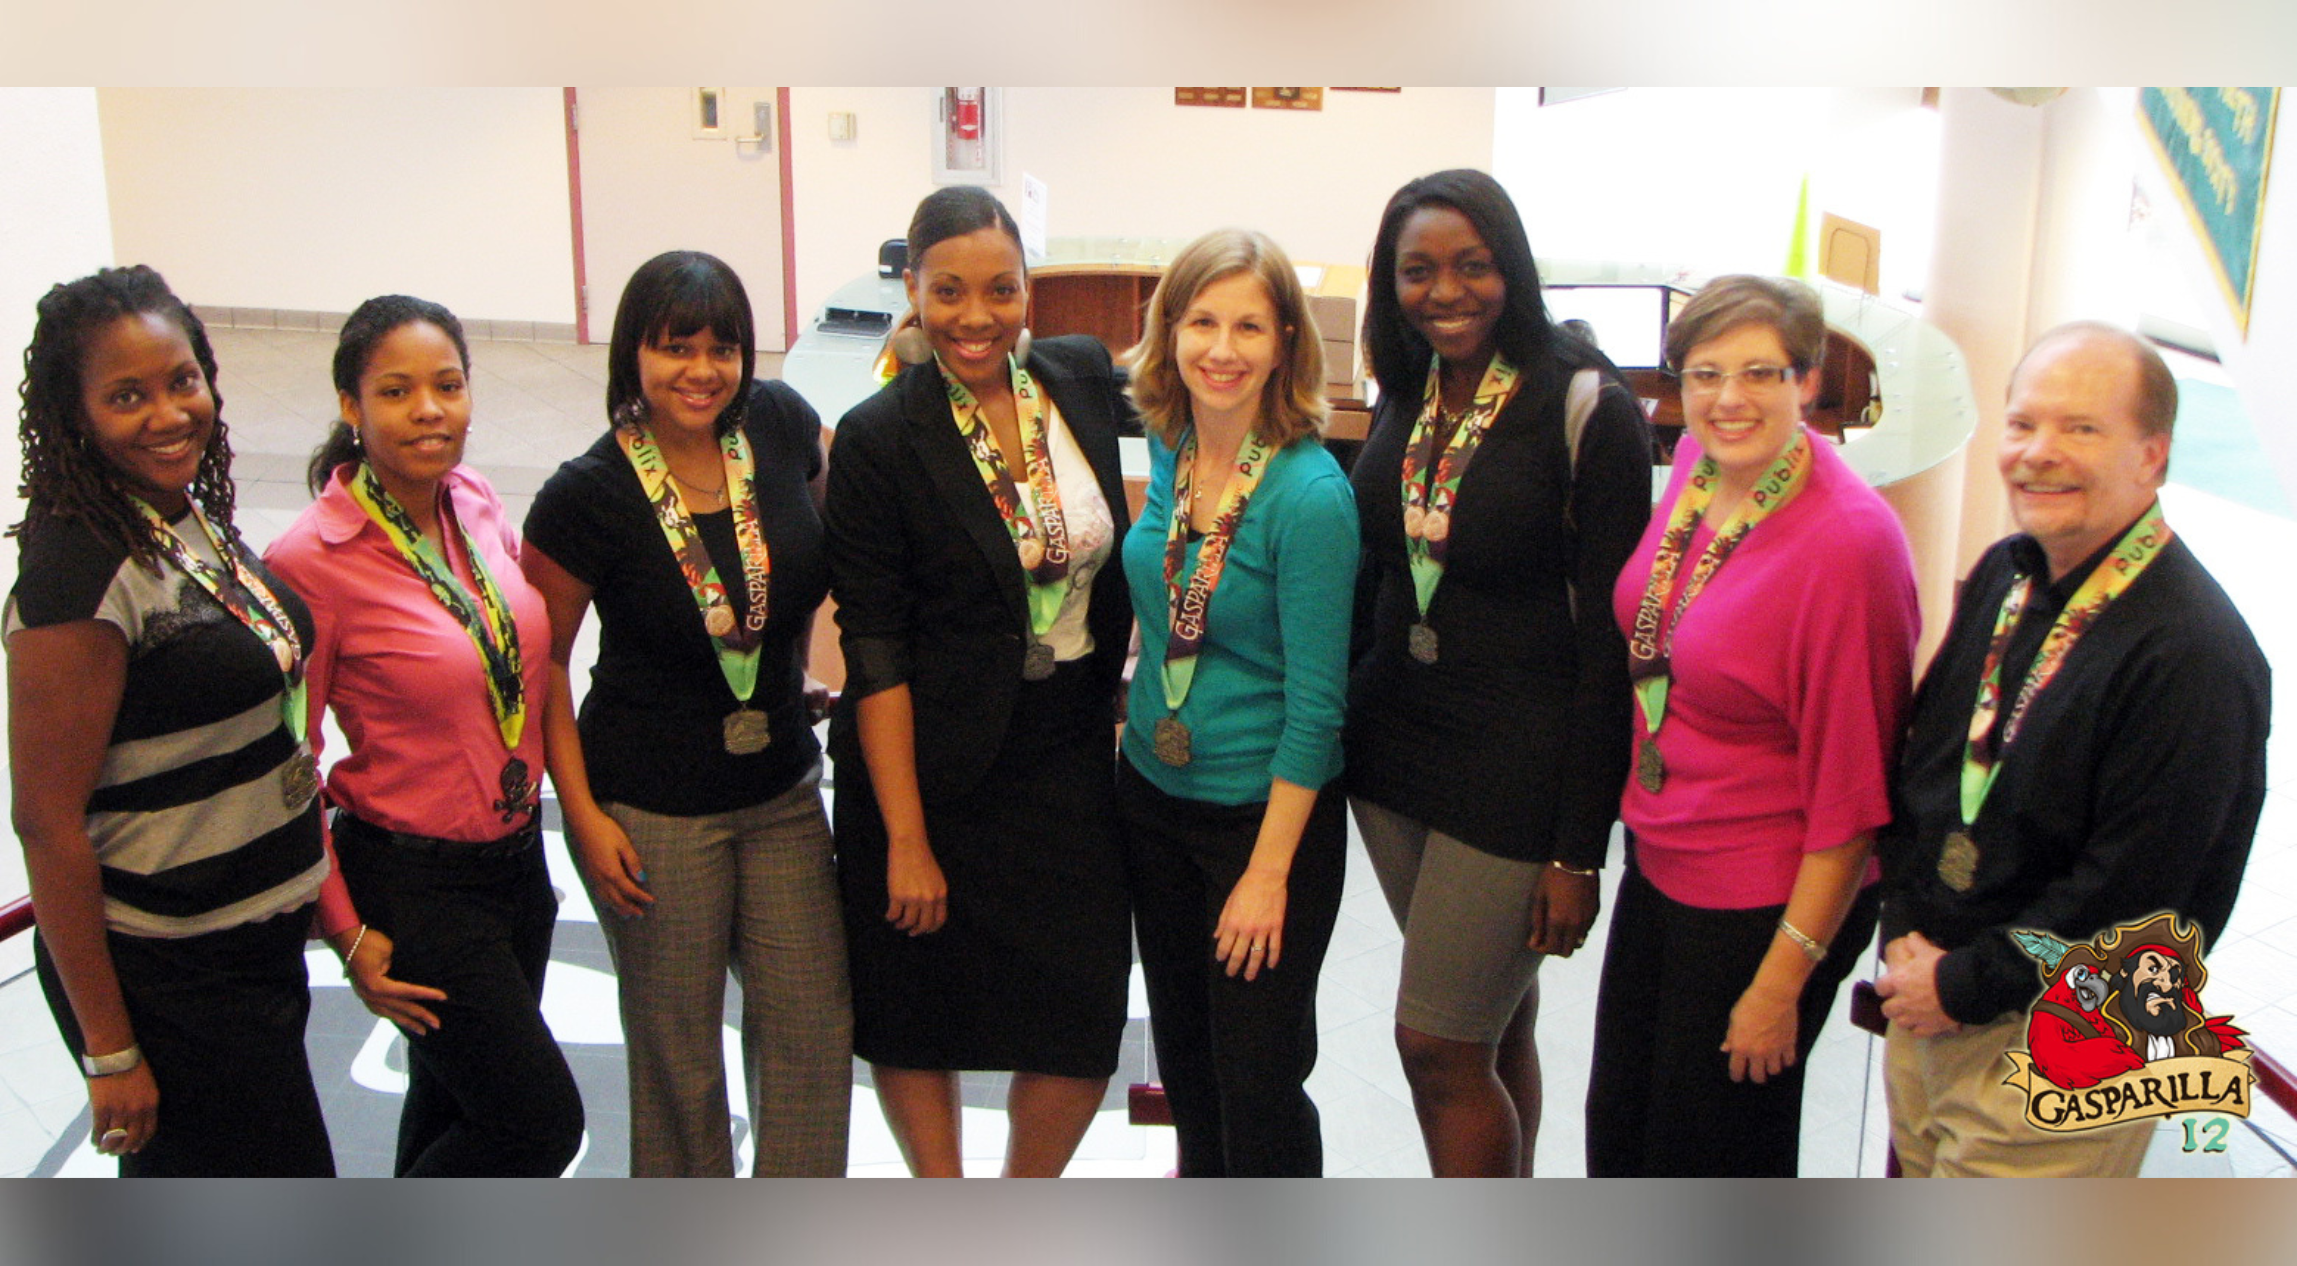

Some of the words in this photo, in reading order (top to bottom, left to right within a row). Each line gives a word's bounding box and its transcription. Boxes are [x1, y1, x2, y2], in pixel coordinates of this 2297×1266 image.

[630, 427, 658, 478] blix
[1239, 438, 1267, 478] Pub
[1037, 457, 1070, 564] GASPARILLA
[2114, 527, 2160, 576] Pub
[743, 518, 770, 631] GASPARILLA
[1174, 535, 1230, 641] GASPARILLA
[1629, 551, 1681, 660] GASPARILLA
